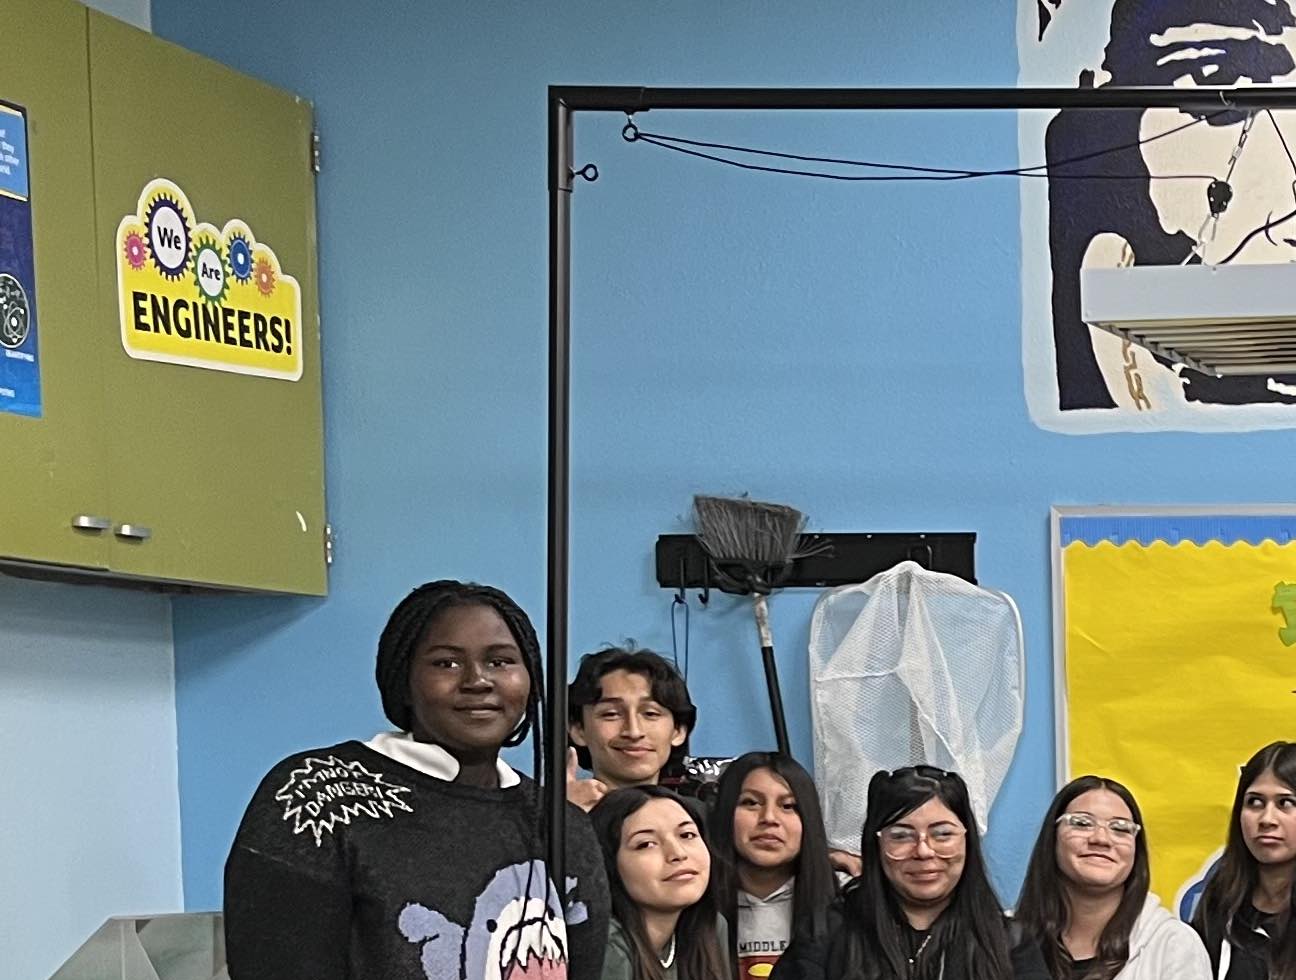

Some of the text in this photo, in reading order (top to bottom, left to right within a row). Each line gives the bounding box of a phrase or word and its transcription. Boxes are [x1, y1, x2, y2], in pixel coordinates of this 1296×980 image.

[158, 226, 221, 282] We Are
[131, 290, 293, 356] ENGINEERS!
[739, 940, 787, 953] MIDDLE
